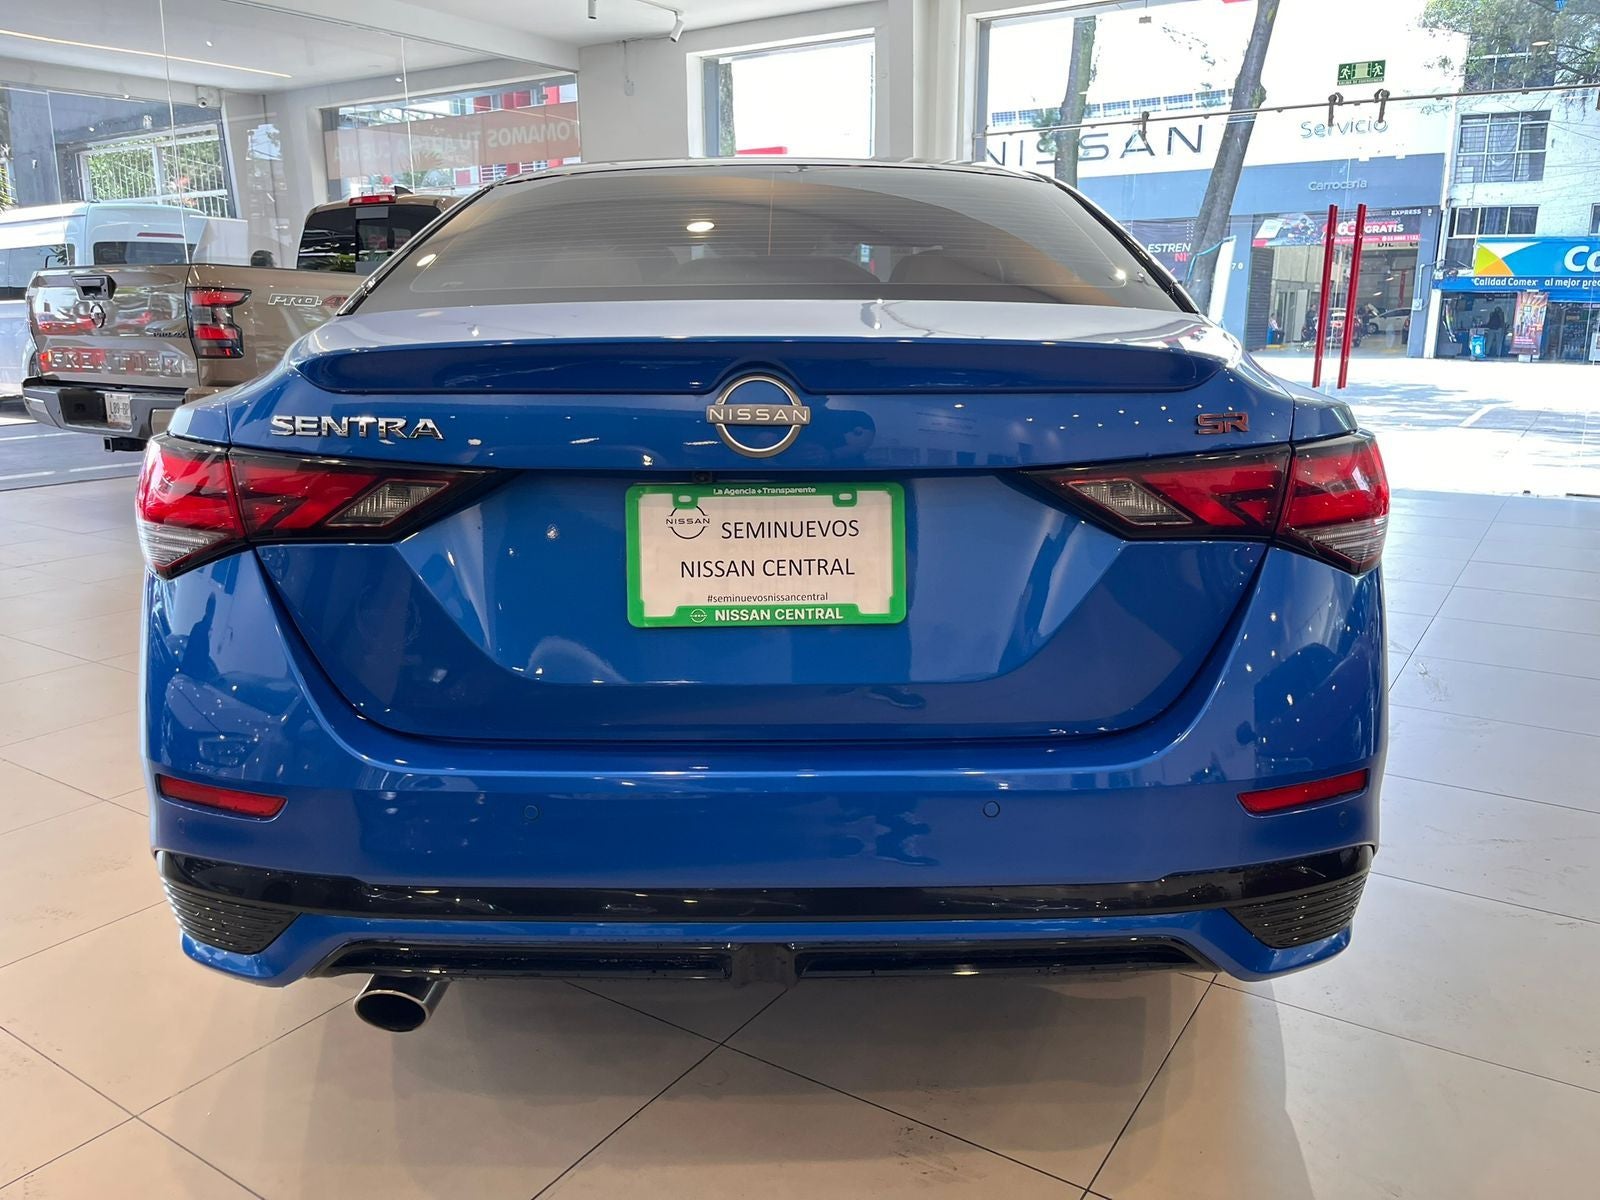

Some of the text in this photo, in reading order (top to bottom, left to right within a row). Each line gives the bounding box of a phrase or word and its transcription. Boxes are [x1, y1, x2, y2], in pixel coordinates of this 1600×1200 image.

[1300, 115, 1389, 139] Servicio
[987, 124, 1203, 166] NISSAN
[1391, 208, 1422, 216] EXPRESS
[1364, 224, 1404, 234] GRATIS
[1148, 243, 1191, 253] ESTREN
[1175, 252, 1191, 262] NI
[1544, 278, 1553, 286] al
[1554, 278, 1581, 289] mejor
[709, 408, 807, 422] NISSAN
[270, 414, 444, 440] SENTRA
[1197, 411, 1250, 435] SR
[724, 487, 756, 497] Agencia
[665, 517, 711, 525] NISSAN
[721, 519, 860, 540] SEMINUEVOS
[680, 557, 855, 578] NISSAN CENTRAL
[707, 592, 828, 604] #seminuevosnissancentral
[715, 608, 771, 622] NISSAN
[774, 607, 844, 621] CENTRAL
